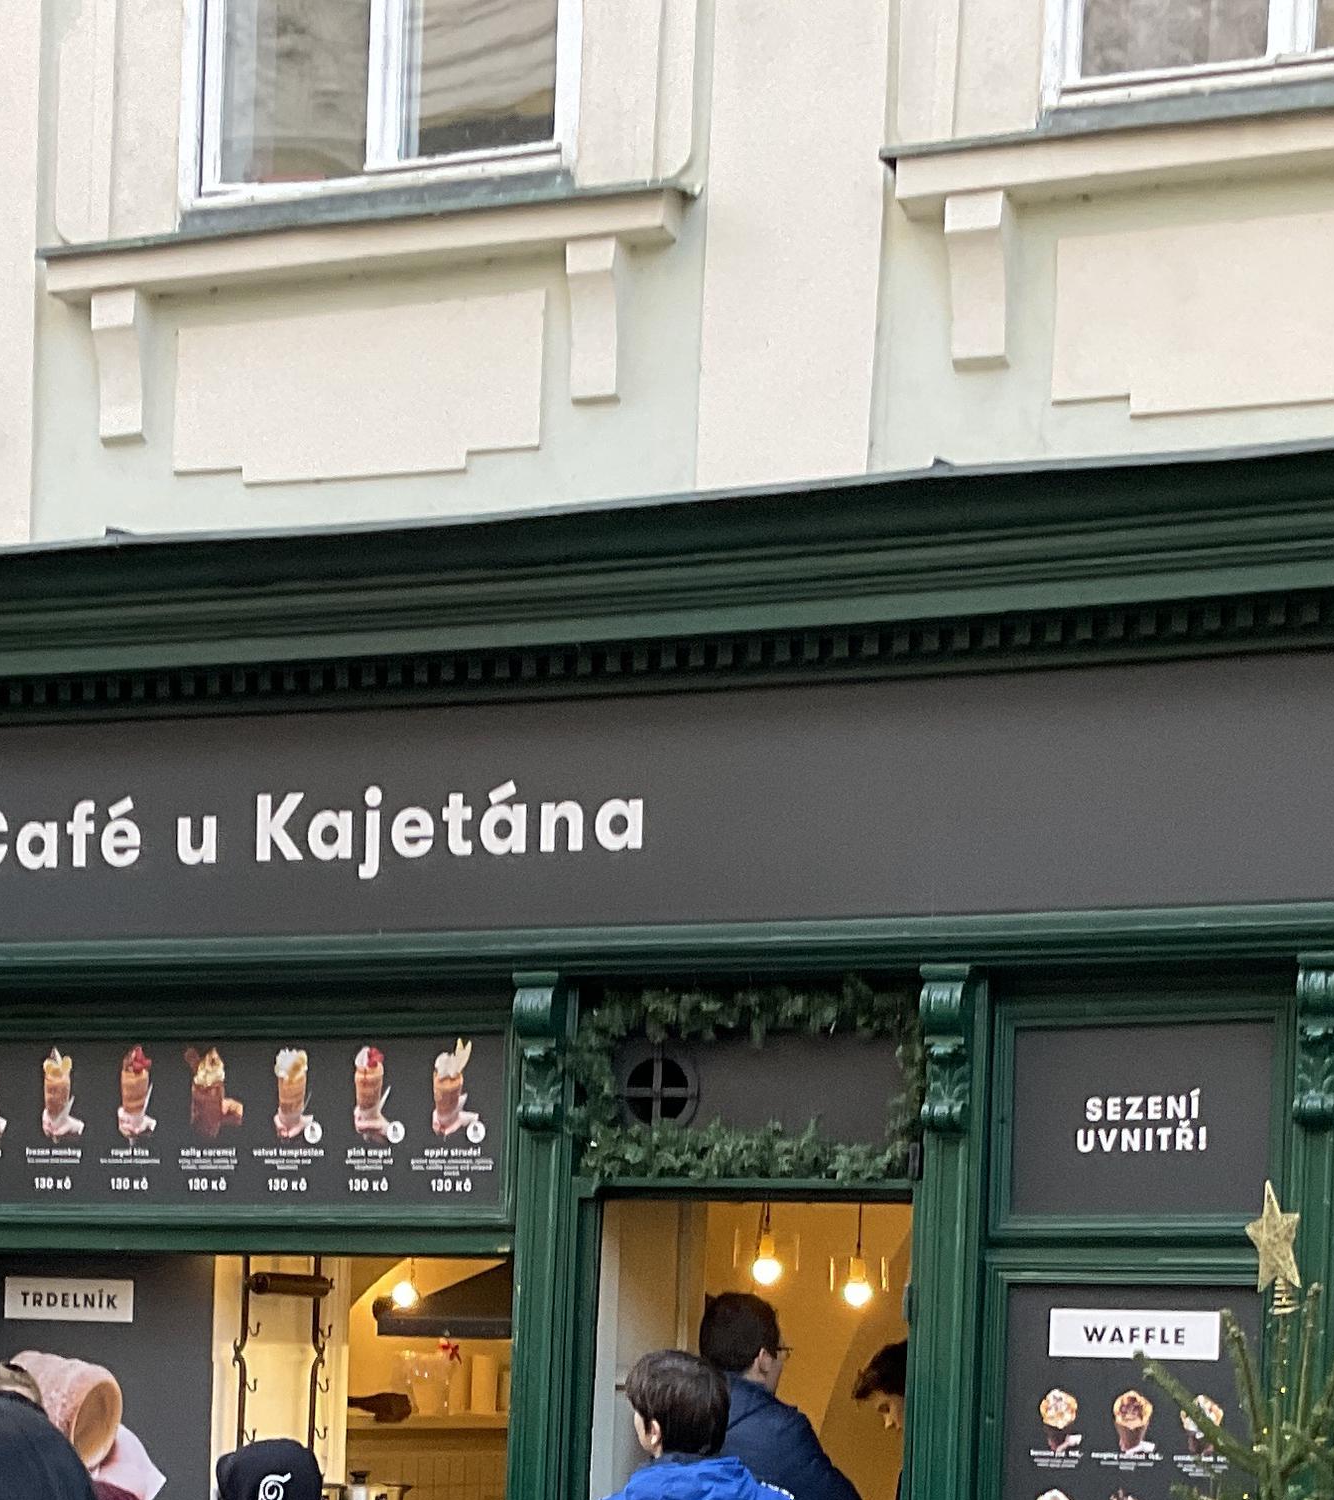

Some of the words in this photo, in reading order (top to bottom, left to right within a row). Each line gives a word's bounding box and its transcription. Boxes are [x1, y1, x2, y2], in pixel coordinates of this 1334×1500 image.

[176, 815, 217, 865] u
[255, 779, 644, 880] Kajetána
[1085, 1088, 1200, 1121] SEZENÍ
[21, 1288, 117, 1309] TRDELNÍK
[1083, 1326, 1185, 1345] WAFFLE
